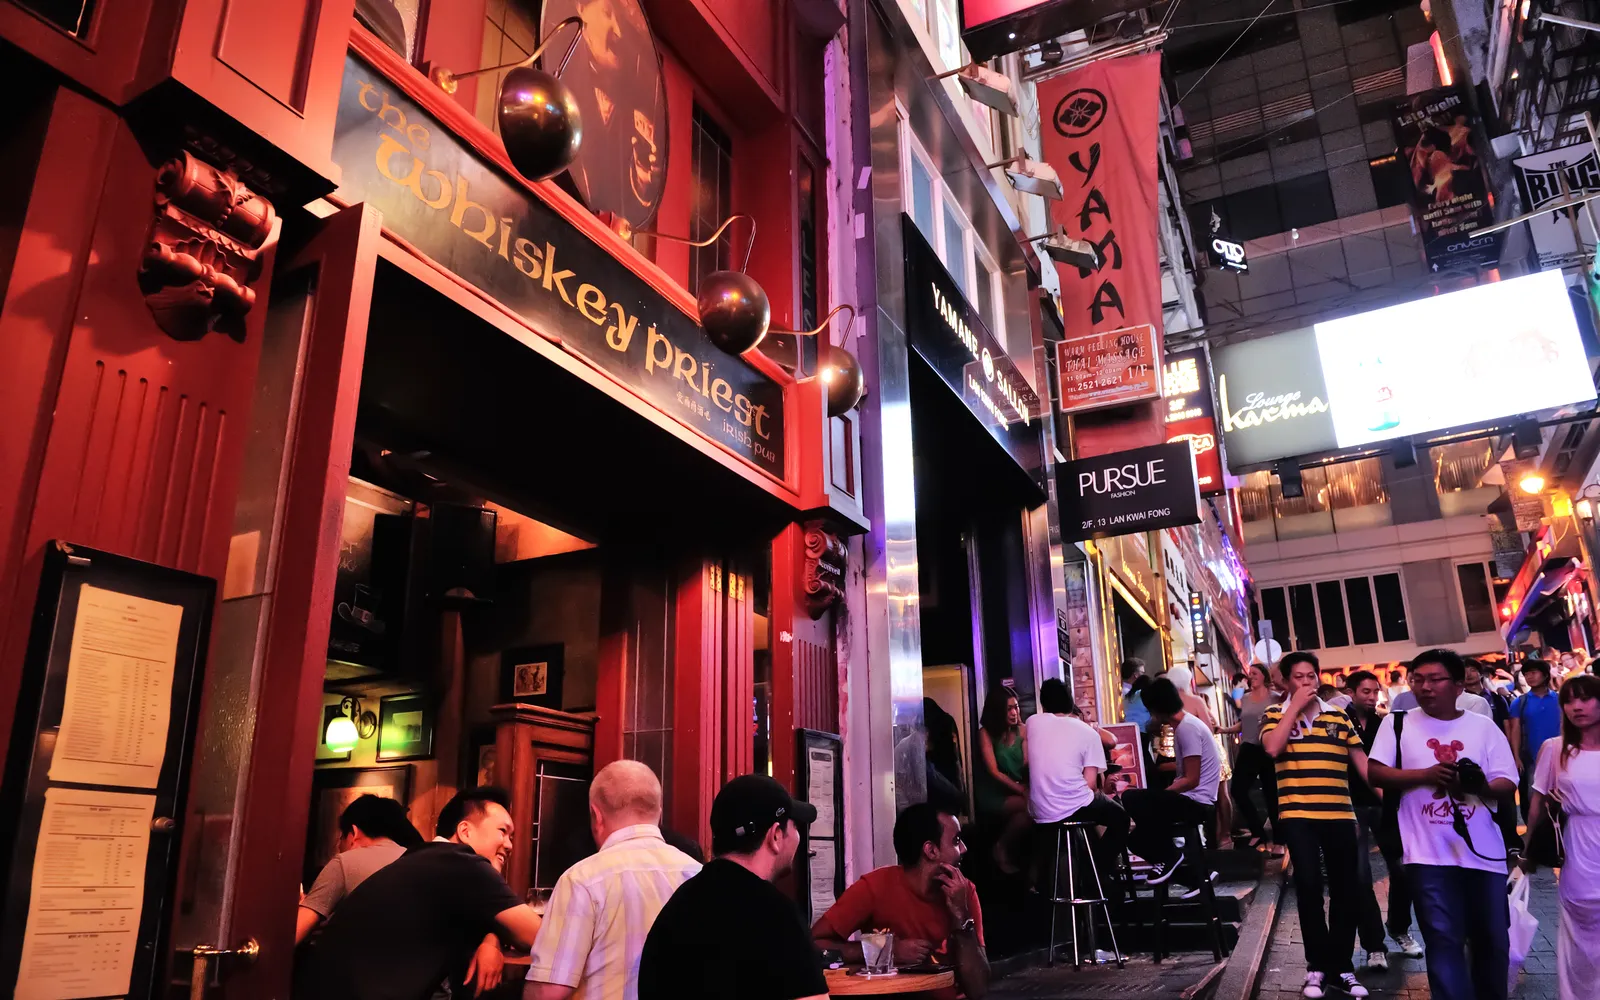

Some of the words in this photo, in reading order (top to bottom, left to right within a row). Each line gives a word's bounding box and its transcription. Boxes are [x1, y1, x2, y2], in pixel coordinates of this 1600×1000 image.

[1548, 160, 1568, 170] THE
[1526, 160, 1600, 205] RING
[931, 282, 979, 361] YAMANE
[1064, 346, 1085, 357] WARM
[1088, 338, 1119, 353] FEELING
[1120, 332, 1144, 346] HOUSE
[1065, 356, 1091, 372] THAI
[1095, 346, 1146, 368] MASSAGE
[1127, 363, 1148, 379] 1/F
[1077, 380, 1099, 391] 2521
[1101, 375, 1123, 386] 2621
[1242, 391, 1301, 412] Lounge
[1078, 458, 1166, 497] PURSUE
[1110, 489, 1136, 499] FASHION
[1098, 517, 1106, 527] 13
[1109, 514, 1125, 525] LAN
[1126, 511, 1147, 523] KWAI
[1147, 507, 1171, 519] FONG
